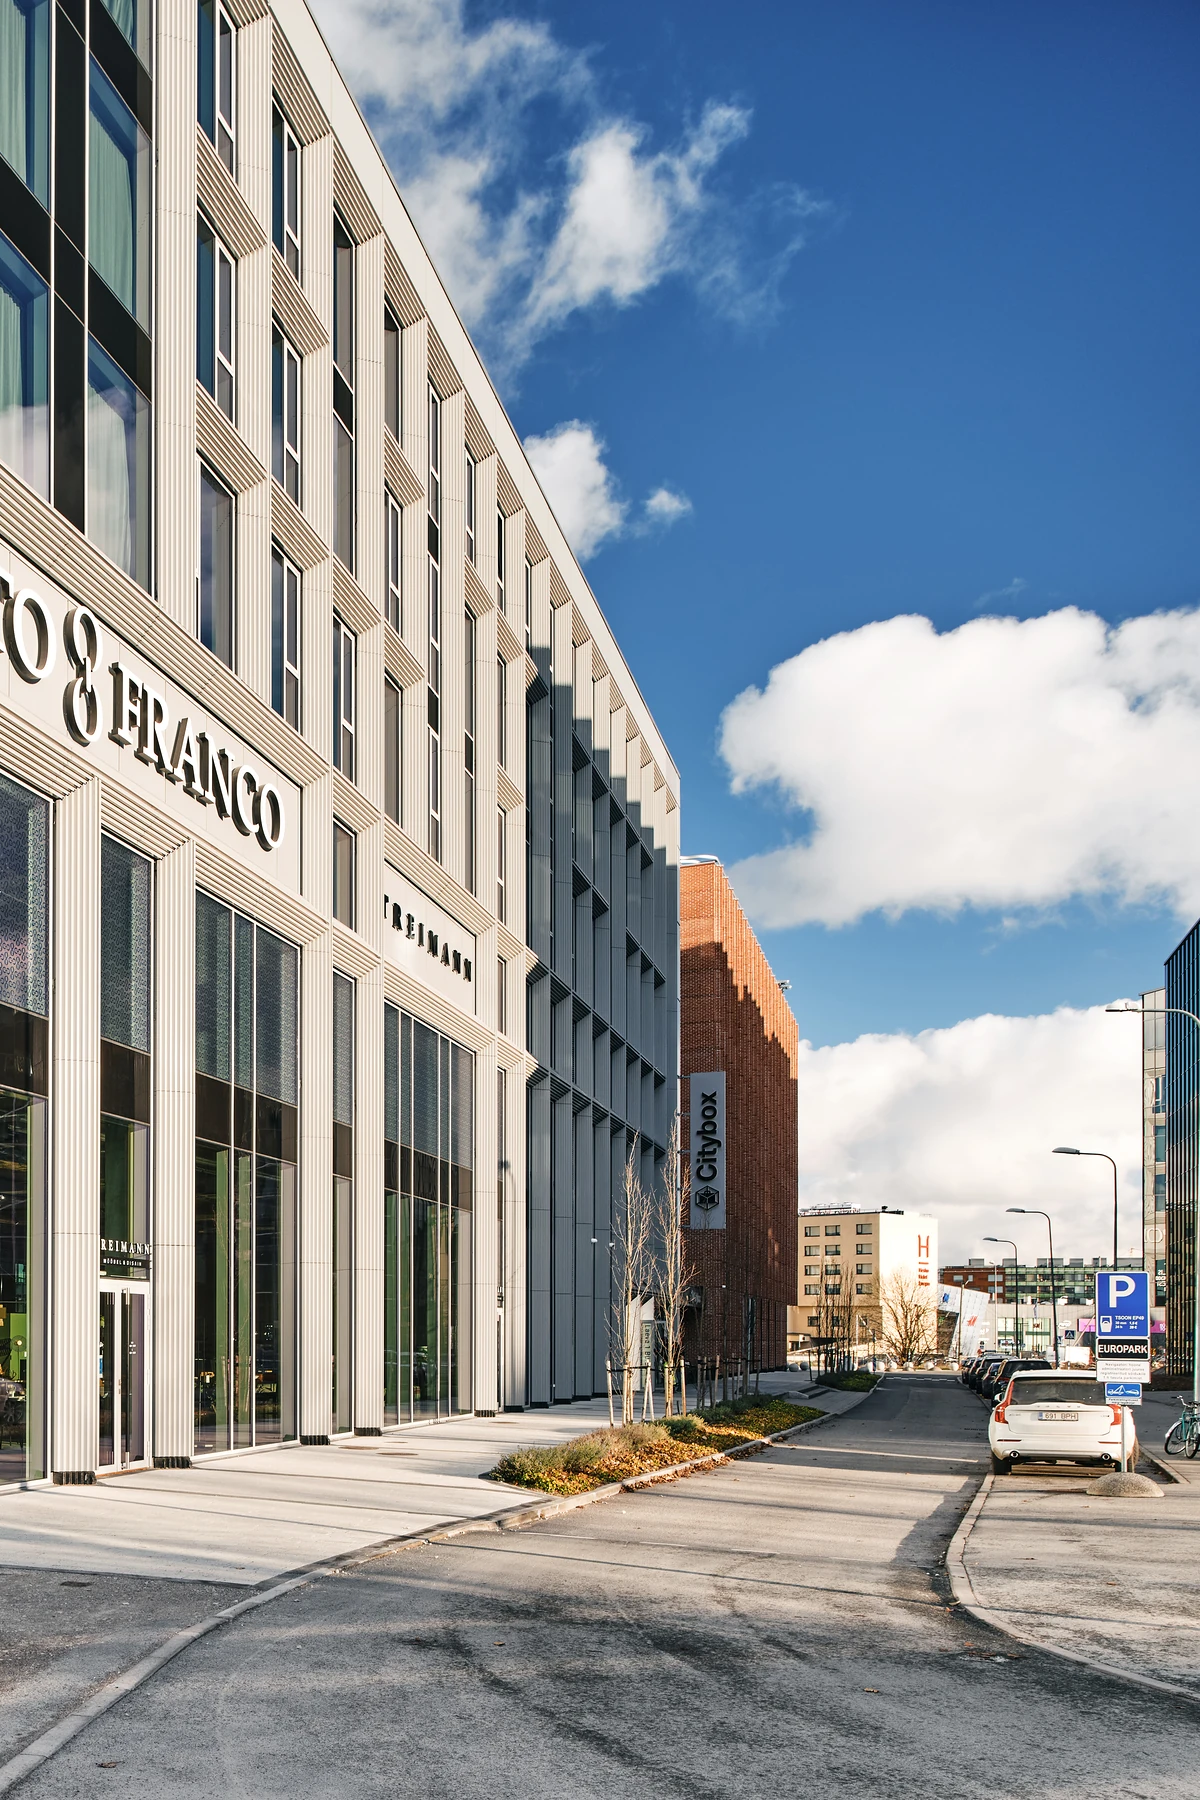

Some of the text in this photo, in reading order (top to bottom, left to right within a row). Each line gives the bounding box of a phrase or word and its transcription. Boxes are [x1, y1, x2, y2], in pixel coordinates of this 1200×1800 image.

[108, 662, 285, 852] FRANCO
[696, 1091, 721, 1181] Citybox
[101, 1239, 150, 1254] REIMANN
[1109, 1275, 1136, 1308] P
[1098, 1344, 1148, 1353] EUROPARK
